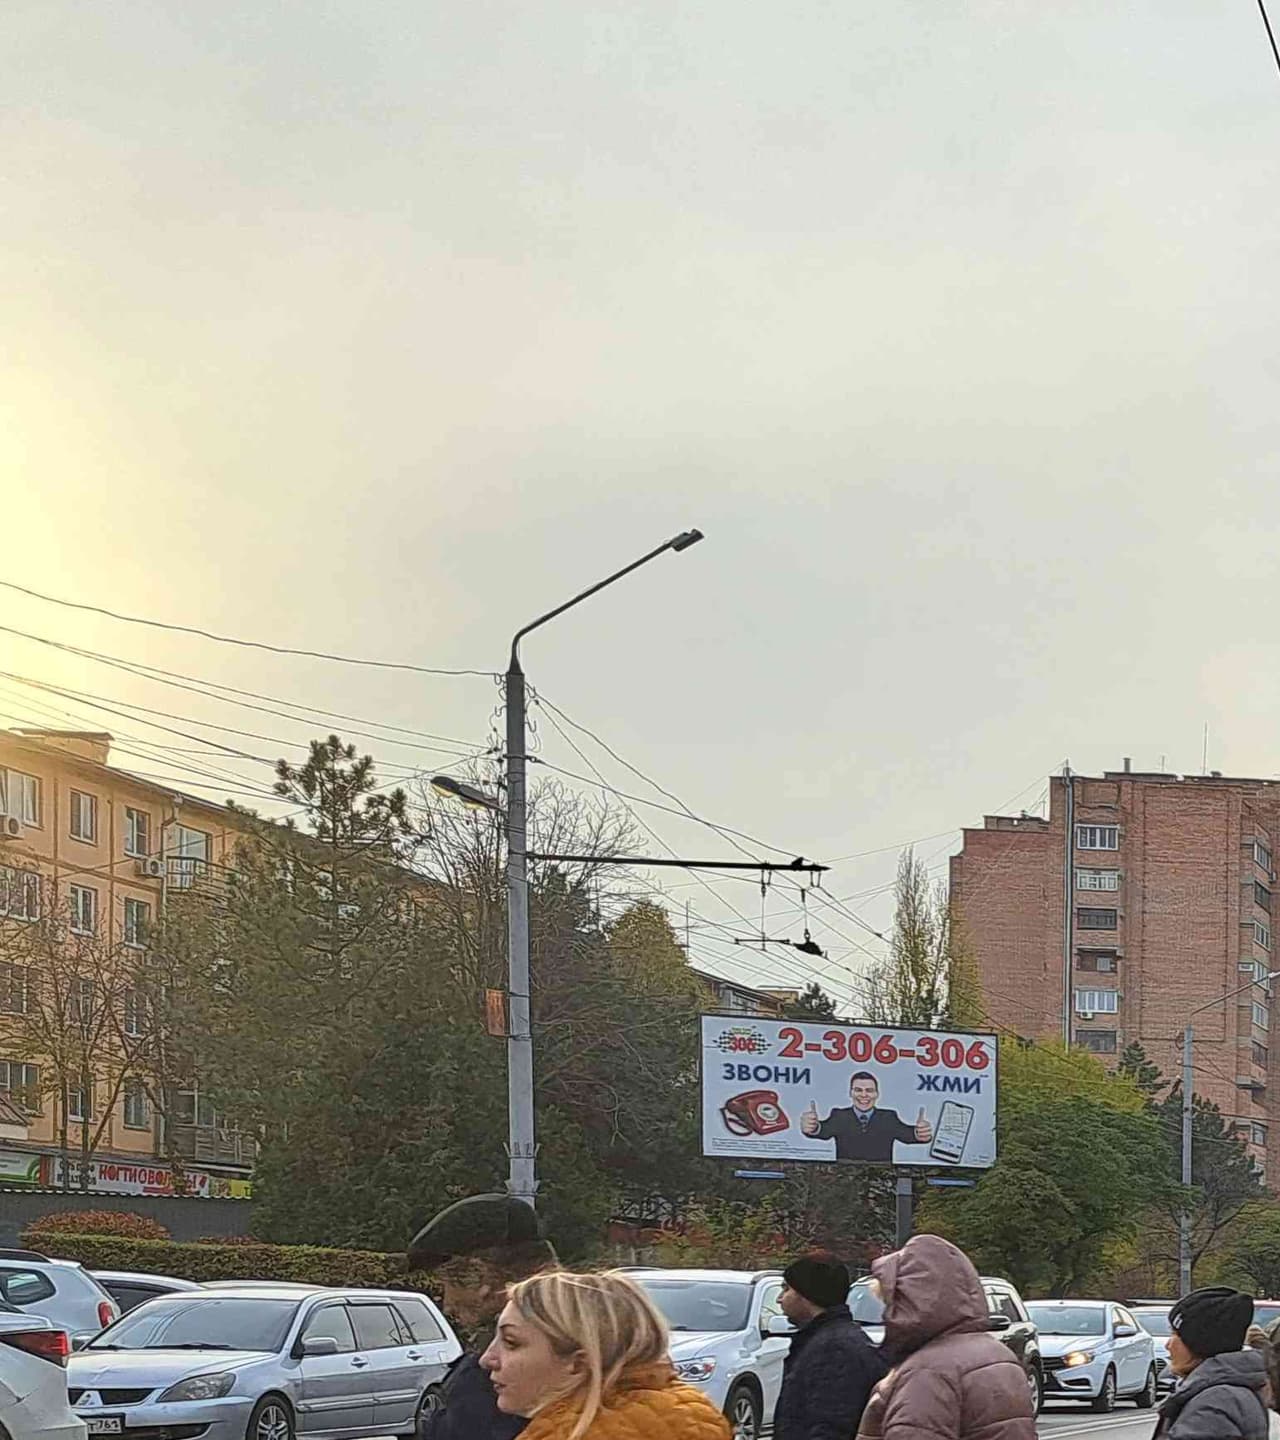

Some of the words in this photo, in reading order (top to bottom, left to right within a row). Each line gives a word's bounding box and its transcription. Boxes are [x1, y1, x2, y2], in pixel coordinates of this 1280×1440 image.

[777, 1027, 990, 1070] 2-306-306
[722, 1062, 811, 1085] ЗВОНИ
[917, 1073, 981, 1095] ЖМИ
